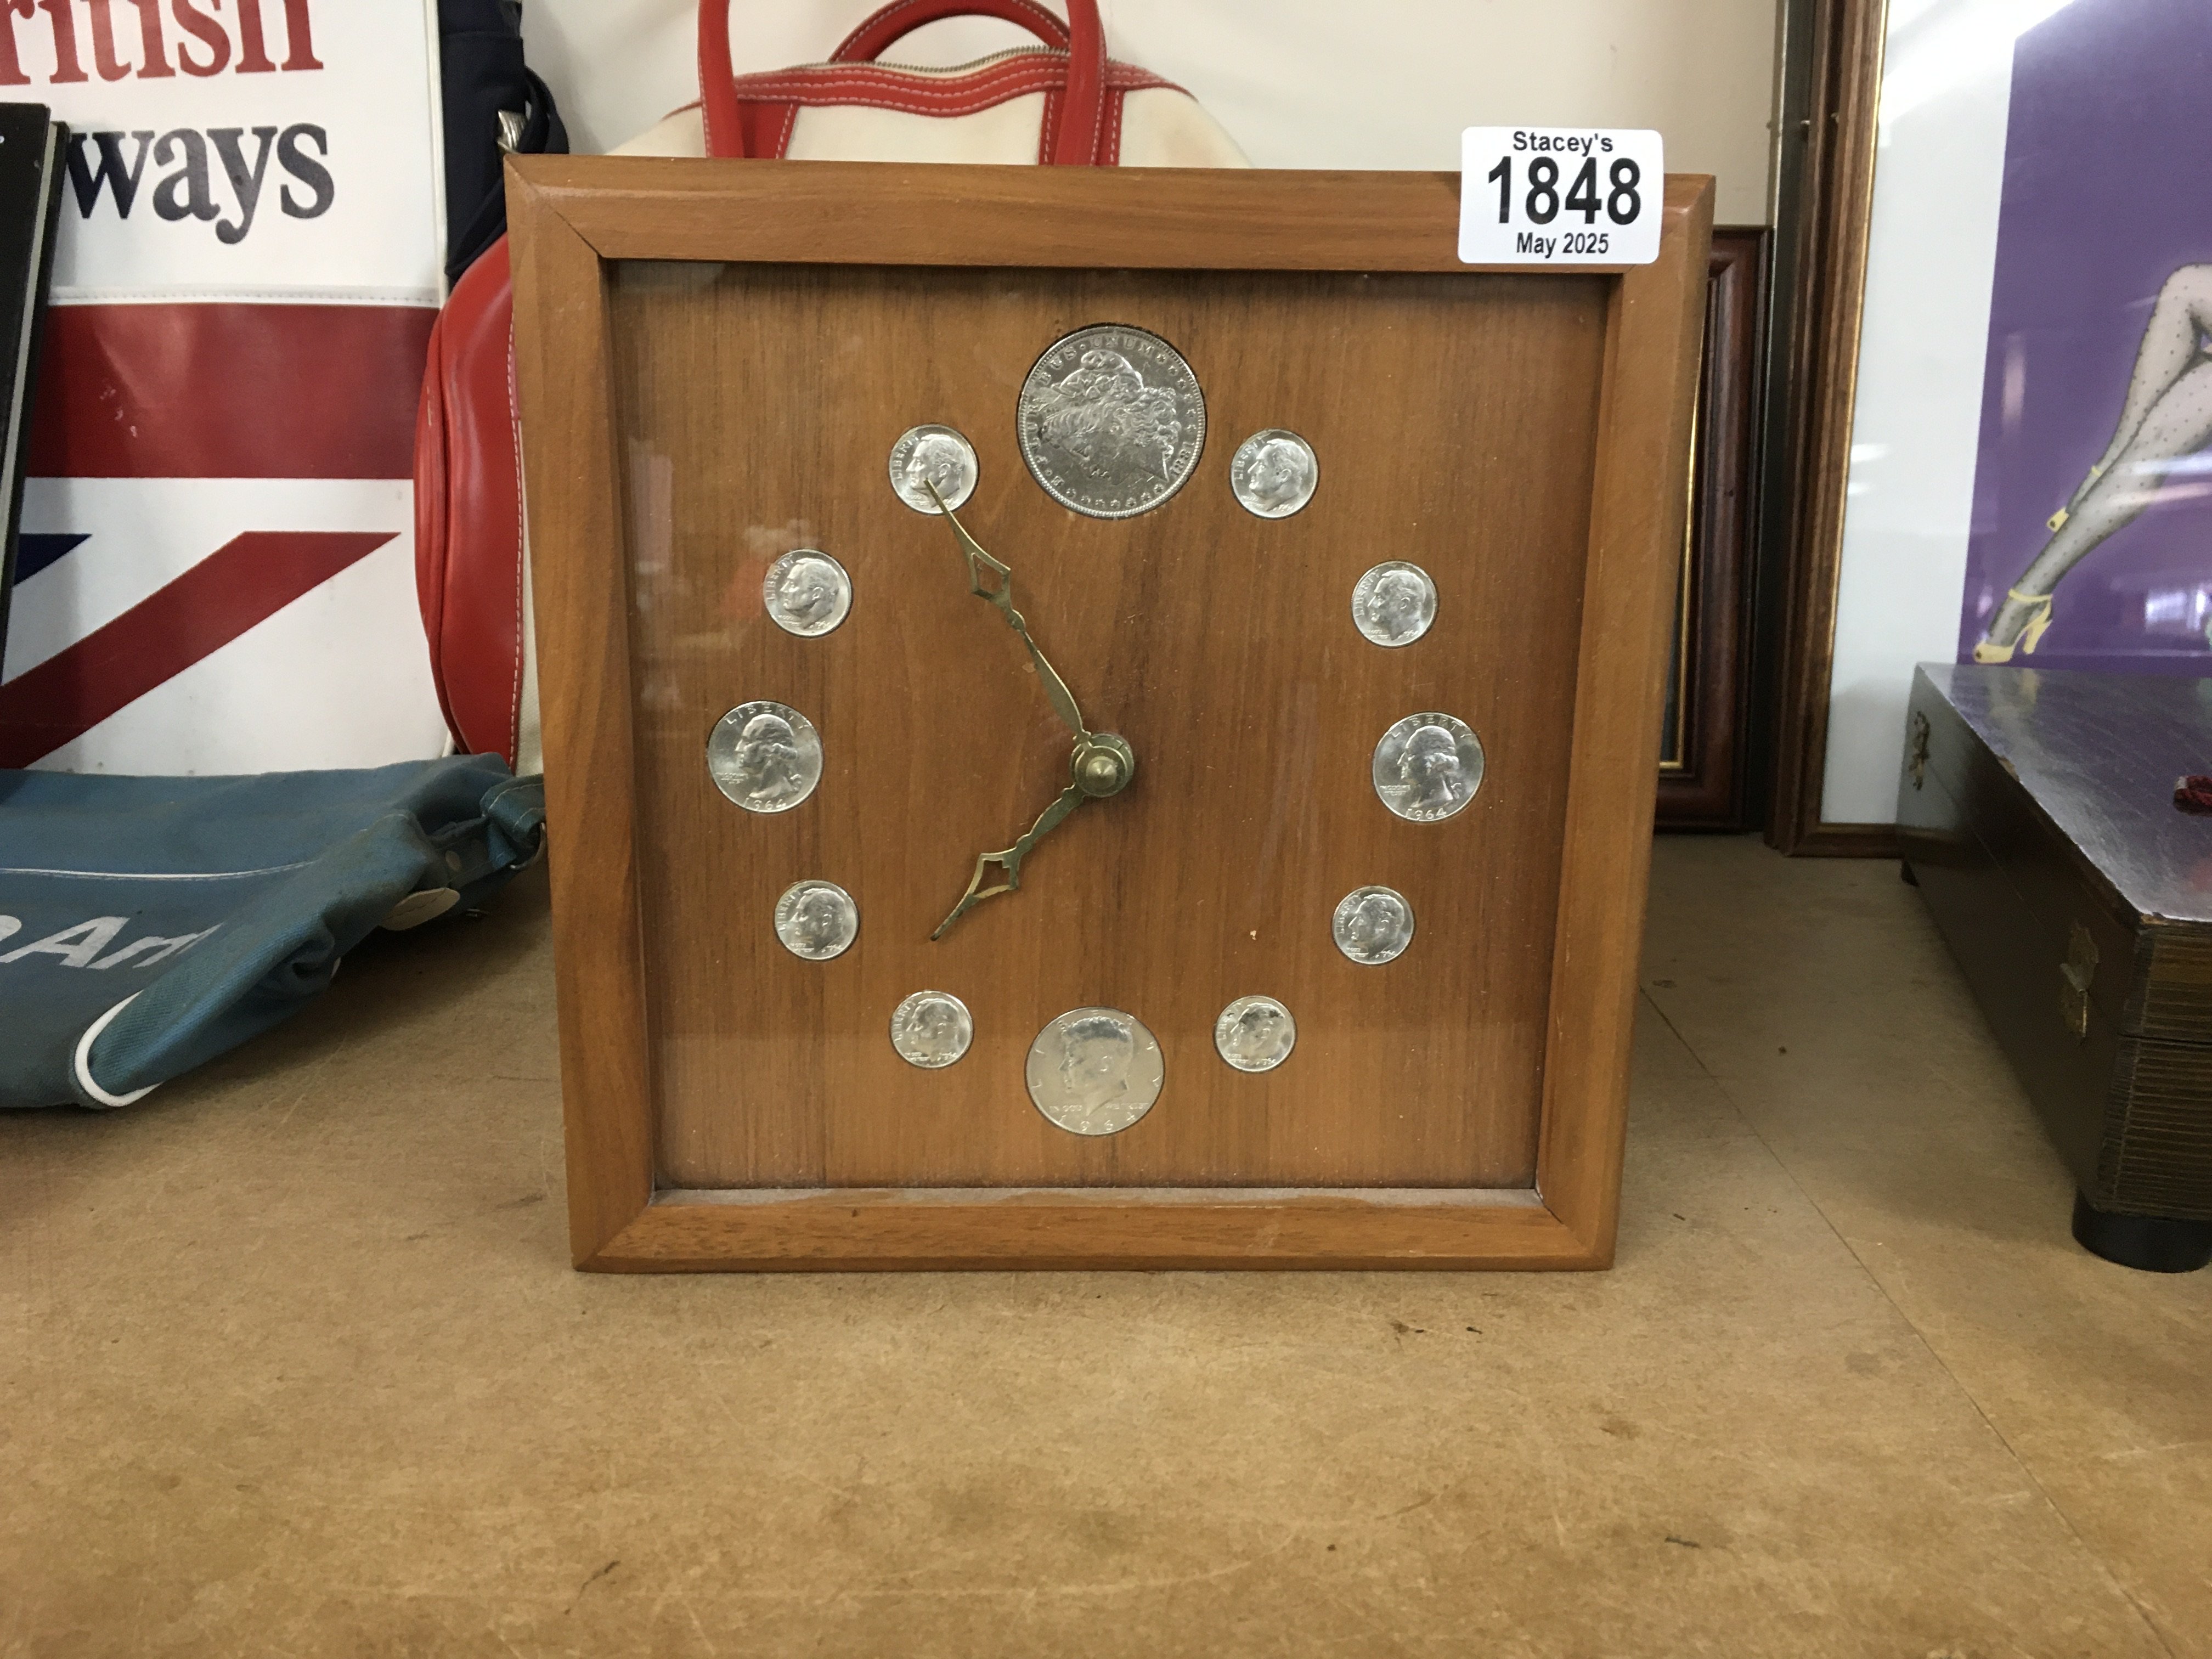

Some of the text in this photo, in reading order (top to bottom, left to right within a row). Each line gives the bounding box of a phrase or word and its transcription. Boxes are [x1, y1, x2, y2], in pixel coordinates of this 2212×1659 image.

[1513, 131, 1614, 157] Stacey's
[1488, 155, 1641, 225] 1848
[1516, 232, 1609, 259] May 2025
